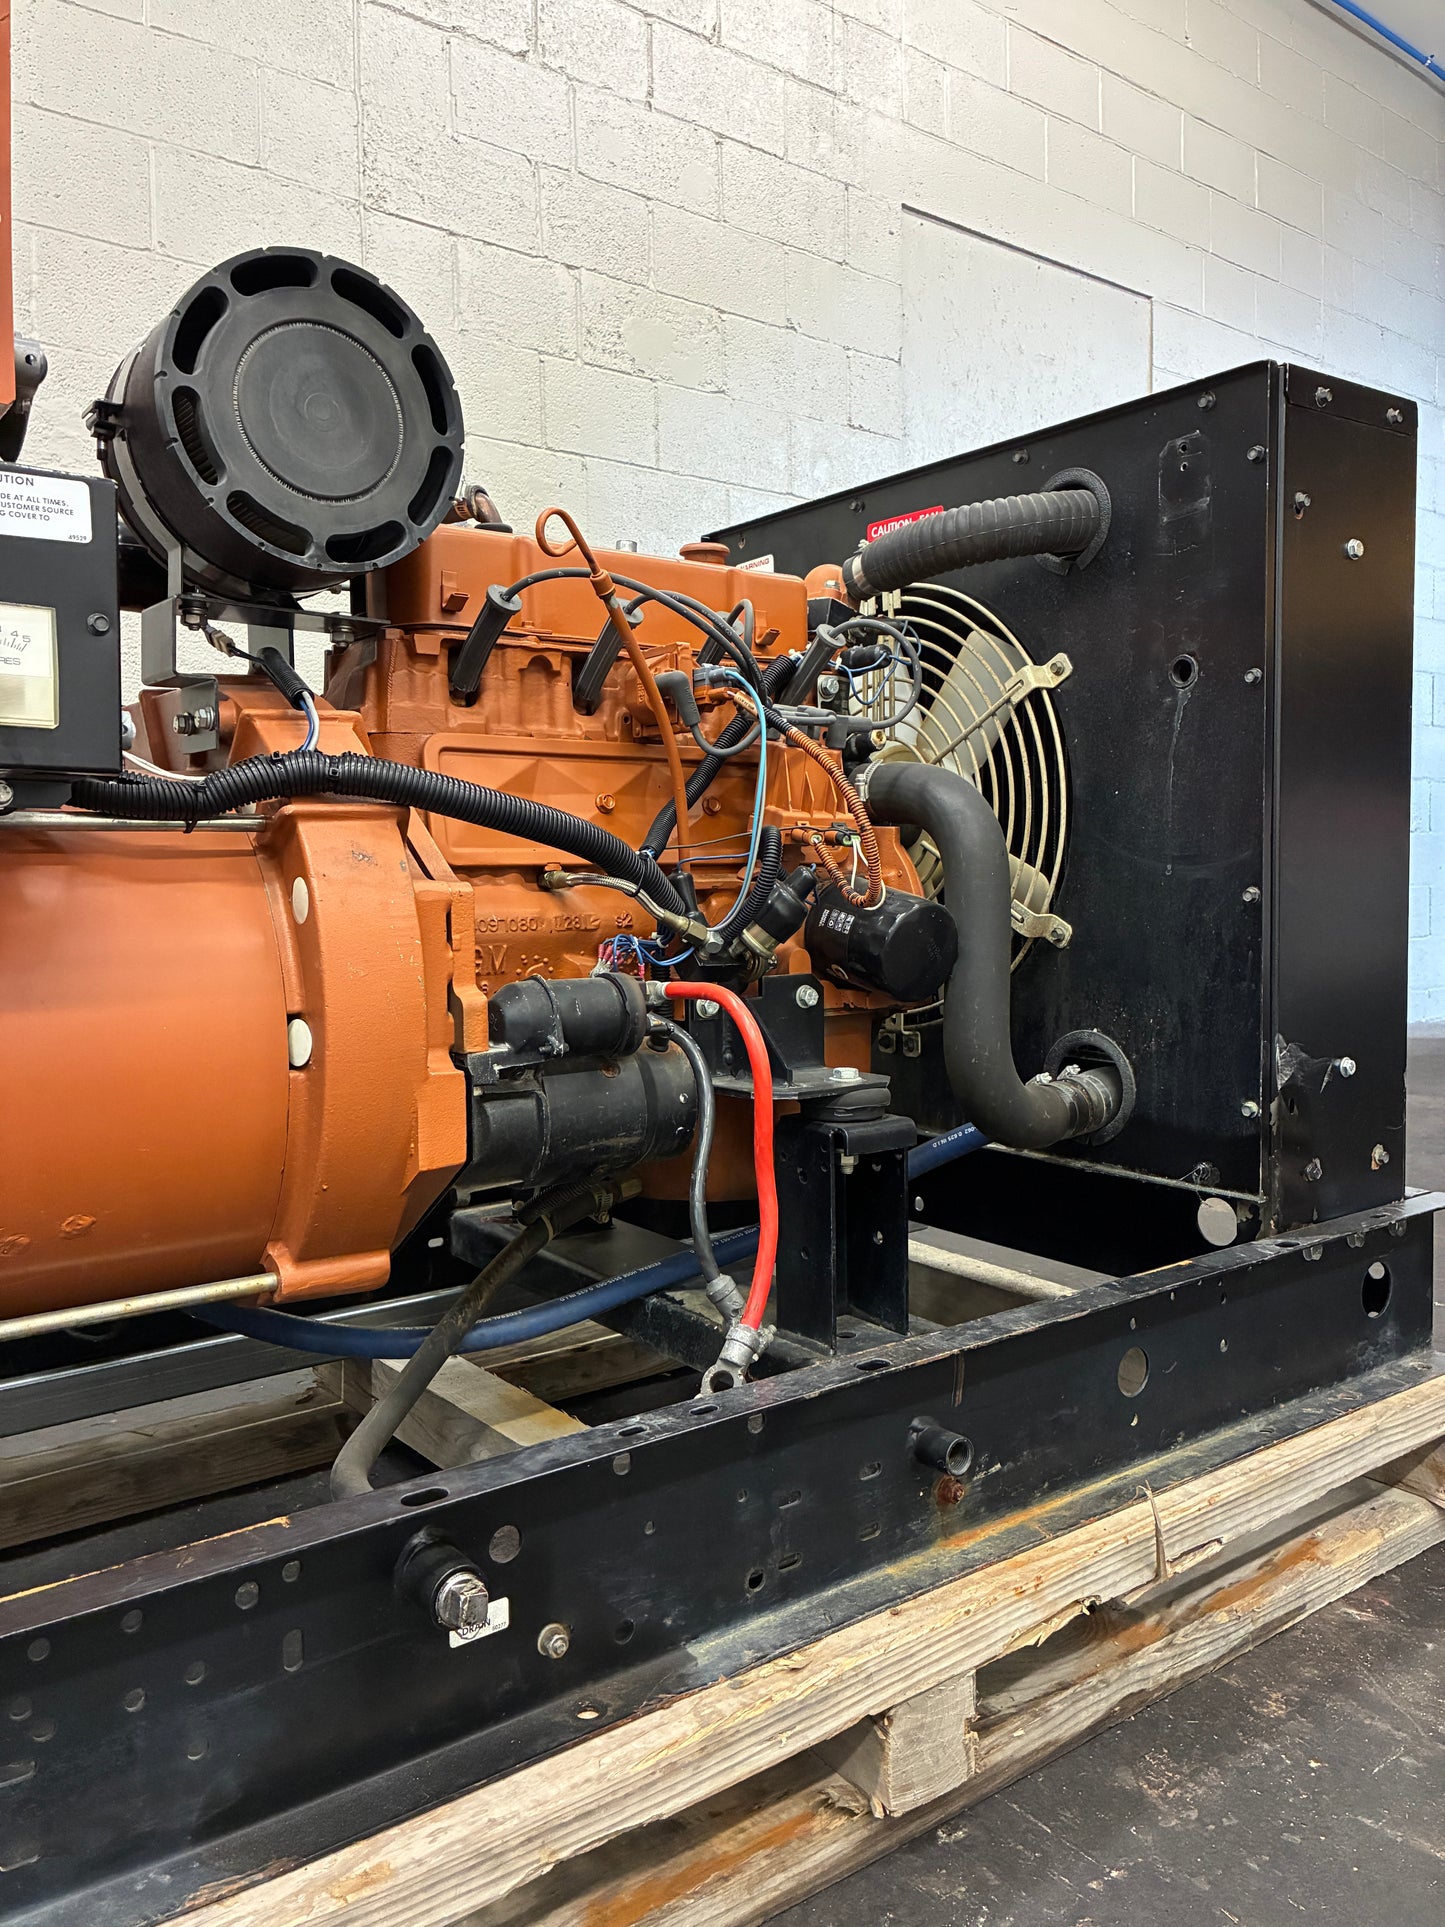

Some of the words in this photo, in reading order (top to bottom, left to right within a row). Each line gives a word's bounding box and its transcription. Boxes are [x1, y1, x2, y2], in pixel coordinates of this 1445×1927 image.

[0, 474, 34, 486] TION
[42, 497, 69, 507] TIMES.
[8, 511, 37, 520] COVER
[42, 506, 74, 516] SOURCE
[871, 518, 913, 538] CAUTION
[22, 635, 31, 643] 5
